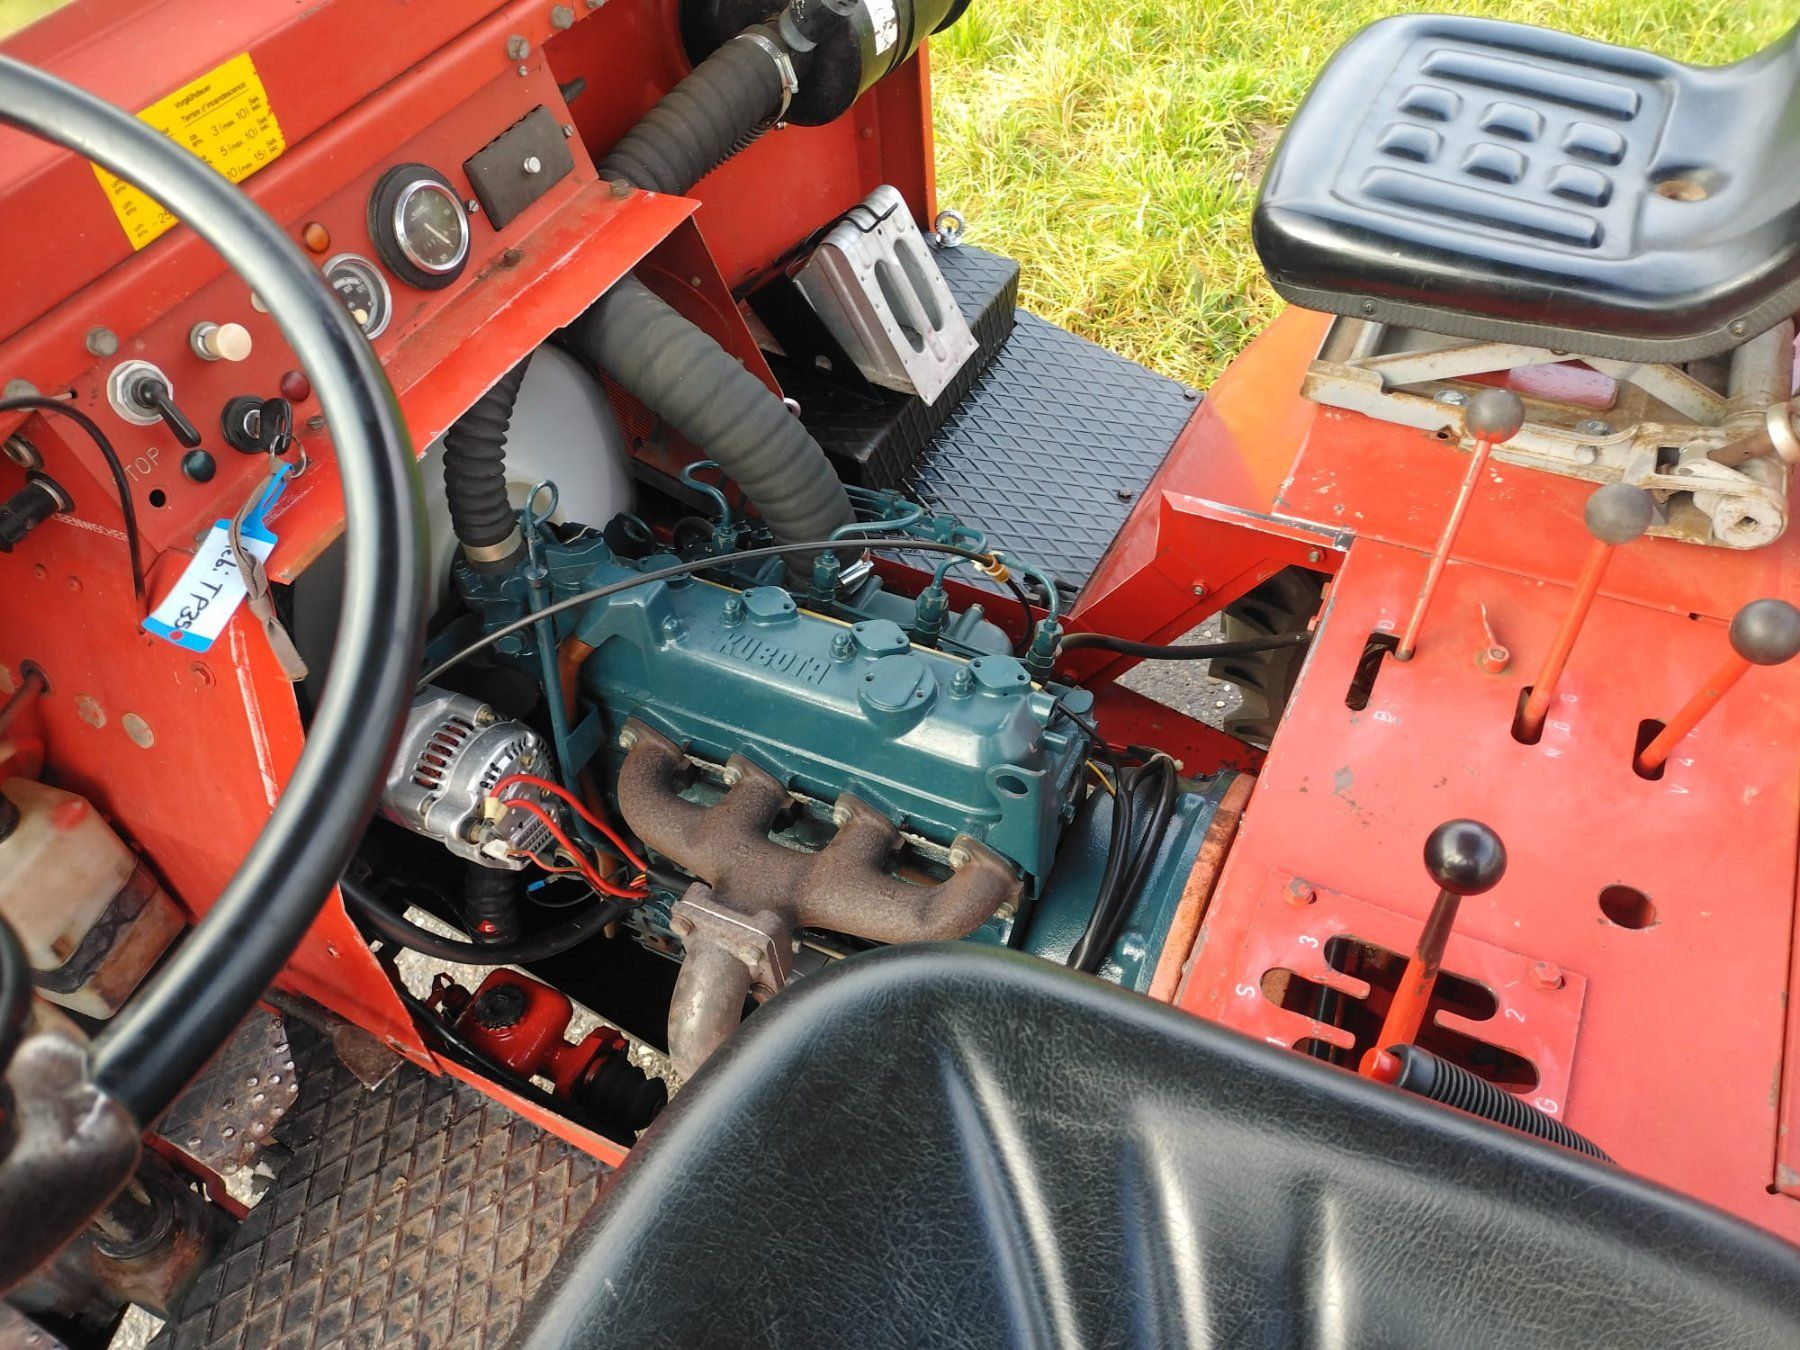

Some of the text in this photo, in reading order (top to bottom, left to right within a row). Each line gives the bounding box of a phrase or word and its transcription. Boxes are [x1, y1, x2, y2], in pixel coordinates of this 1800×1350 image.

[181, 109, 201, 122] Temps
[211, 125, 219, 136] 3
[220, 146, 228, 156] 5
[226, 167, 237, 179] 10
[112, 447, 159, 487] TOP
[174, 580, 223, 629] TP35
[715, 632, 832, 685] KUBOTA
[1298, 935, 1319, 949] 3
[1504, 1007, 1526, 1024] 2
